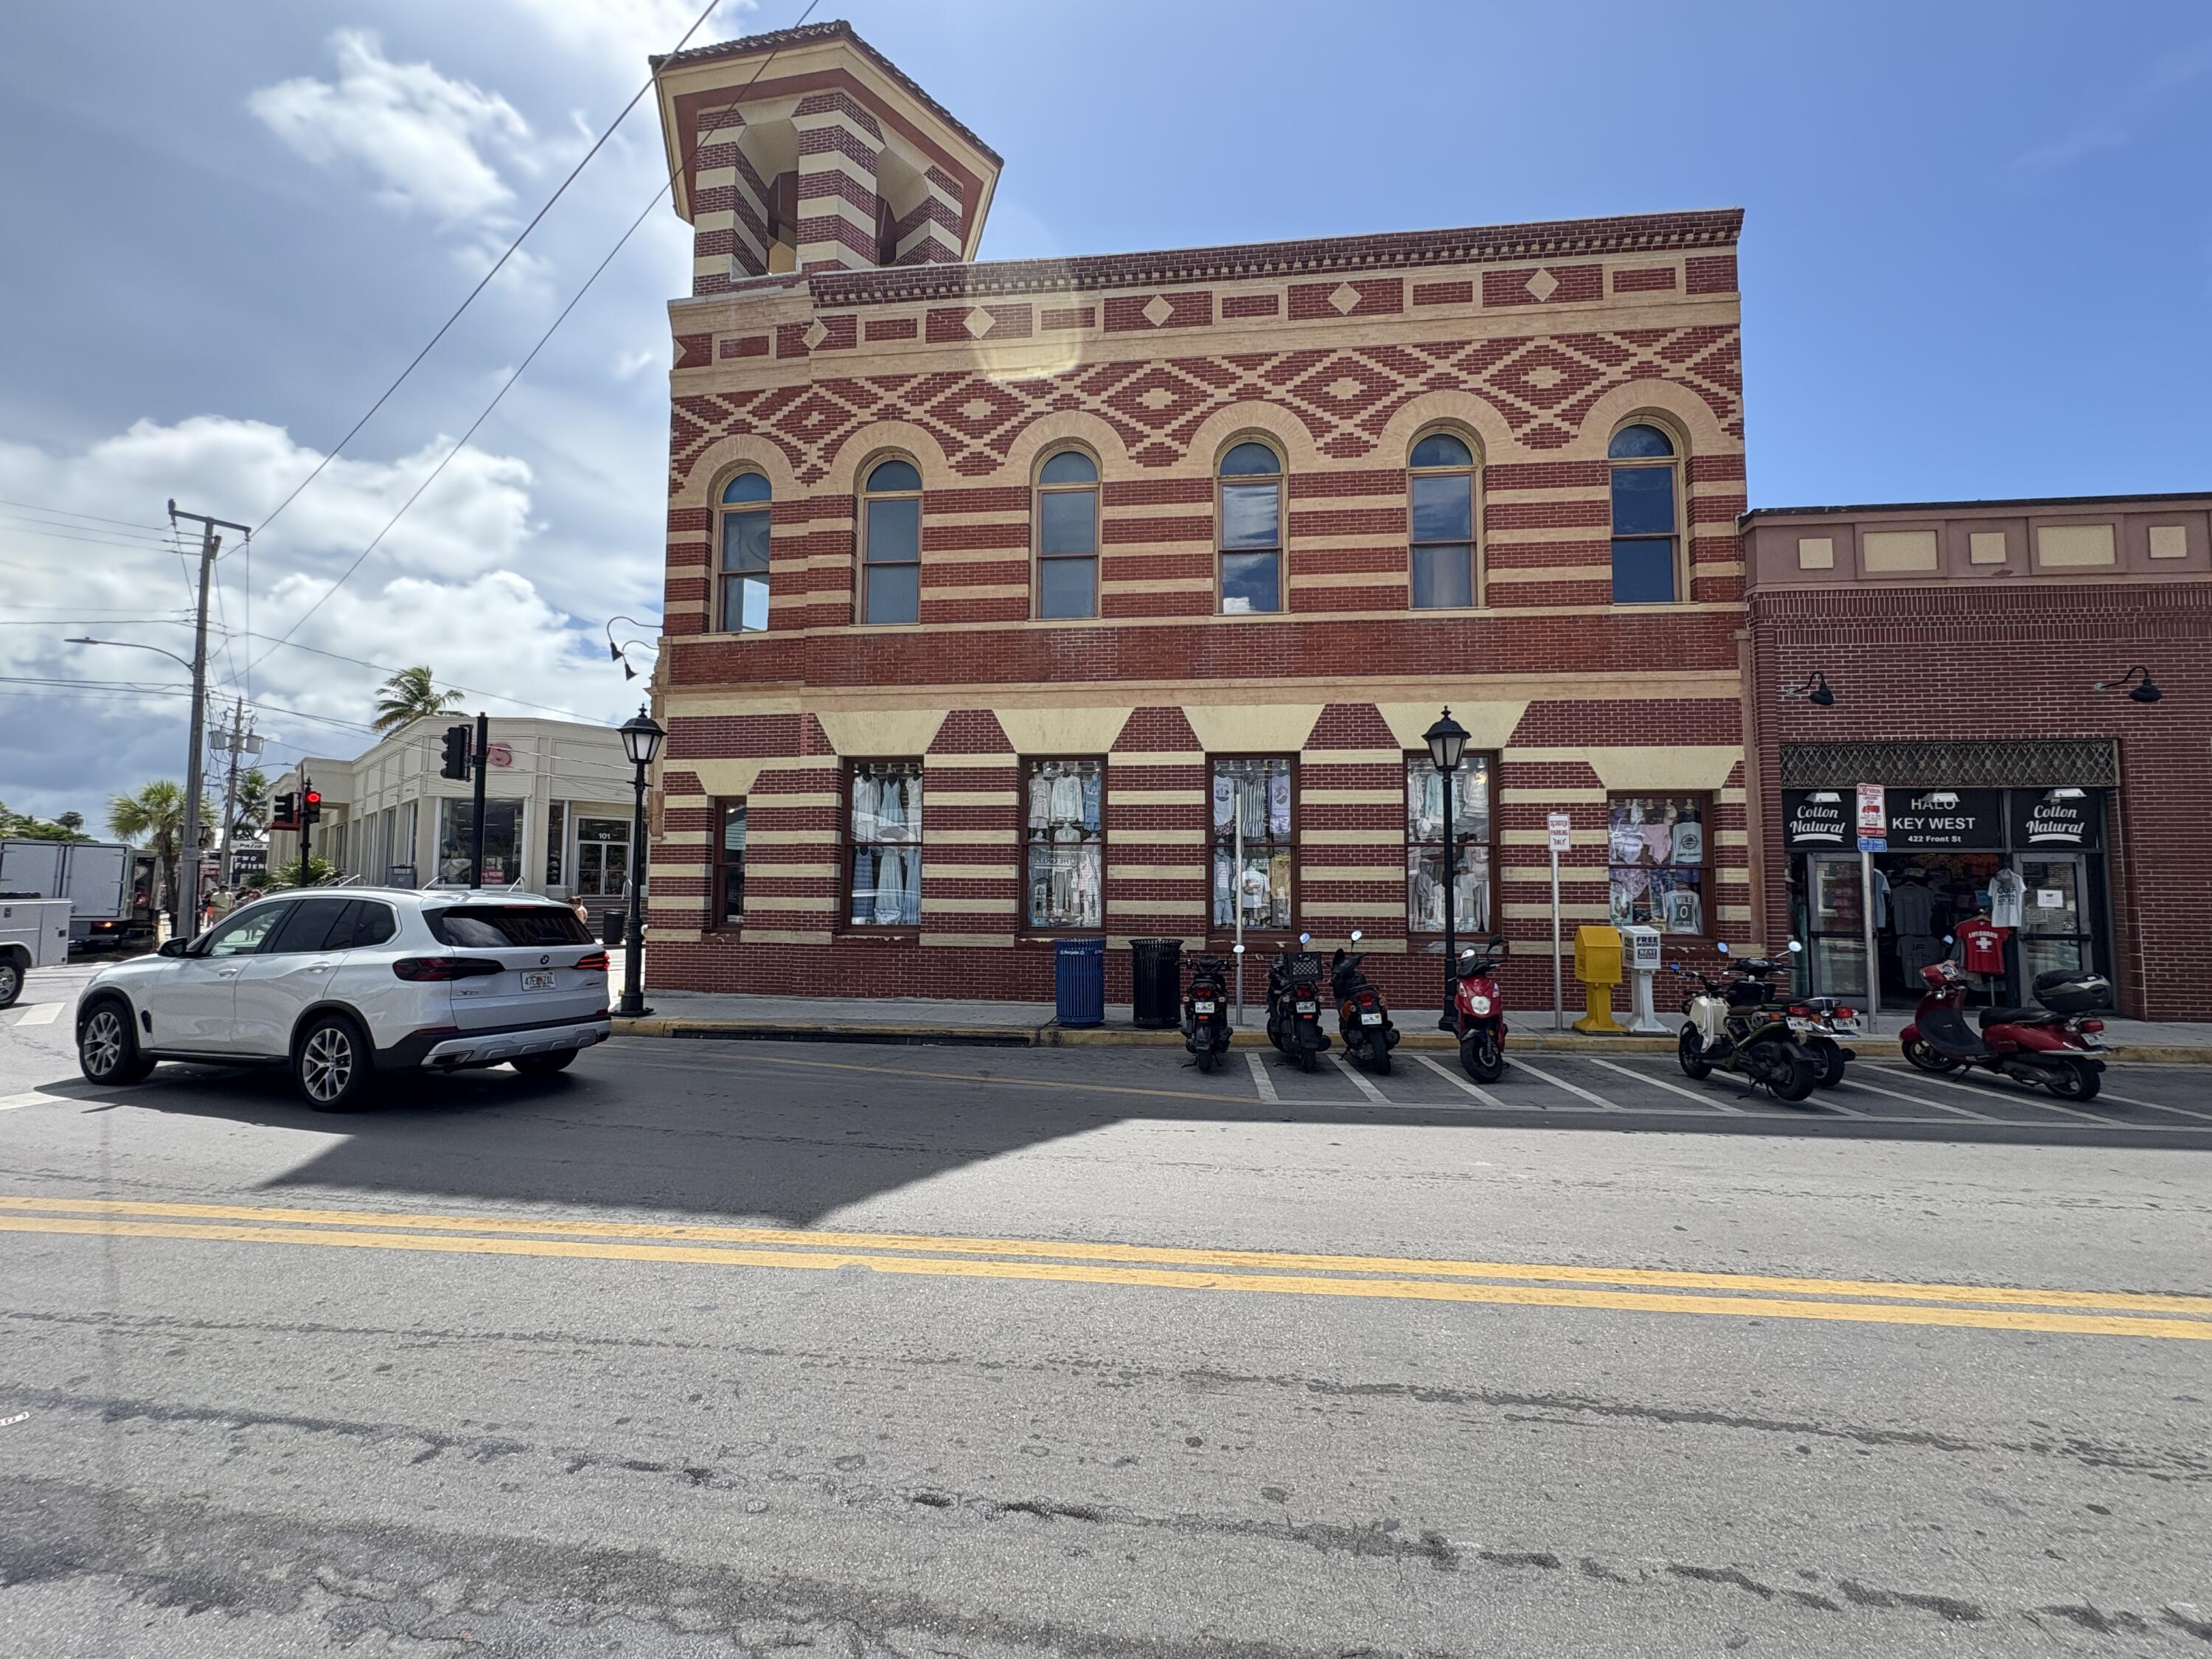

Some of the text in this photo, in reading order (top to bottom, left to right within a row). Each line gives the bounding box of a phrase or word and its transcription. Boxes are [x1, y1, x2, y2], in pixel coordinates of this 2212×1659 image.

[1858, 785, 1866, 795] NO
[1911, 799, 1956, 810] HALO
[1790, 820, 1846, 833] Natural
[1892, 818, 1976, 830] KEY WEST
[2025, 820, 2085, 834] Natural
[1676, 897, 1692, 905] MILE
[1680, 905, 1688, 919] 0
